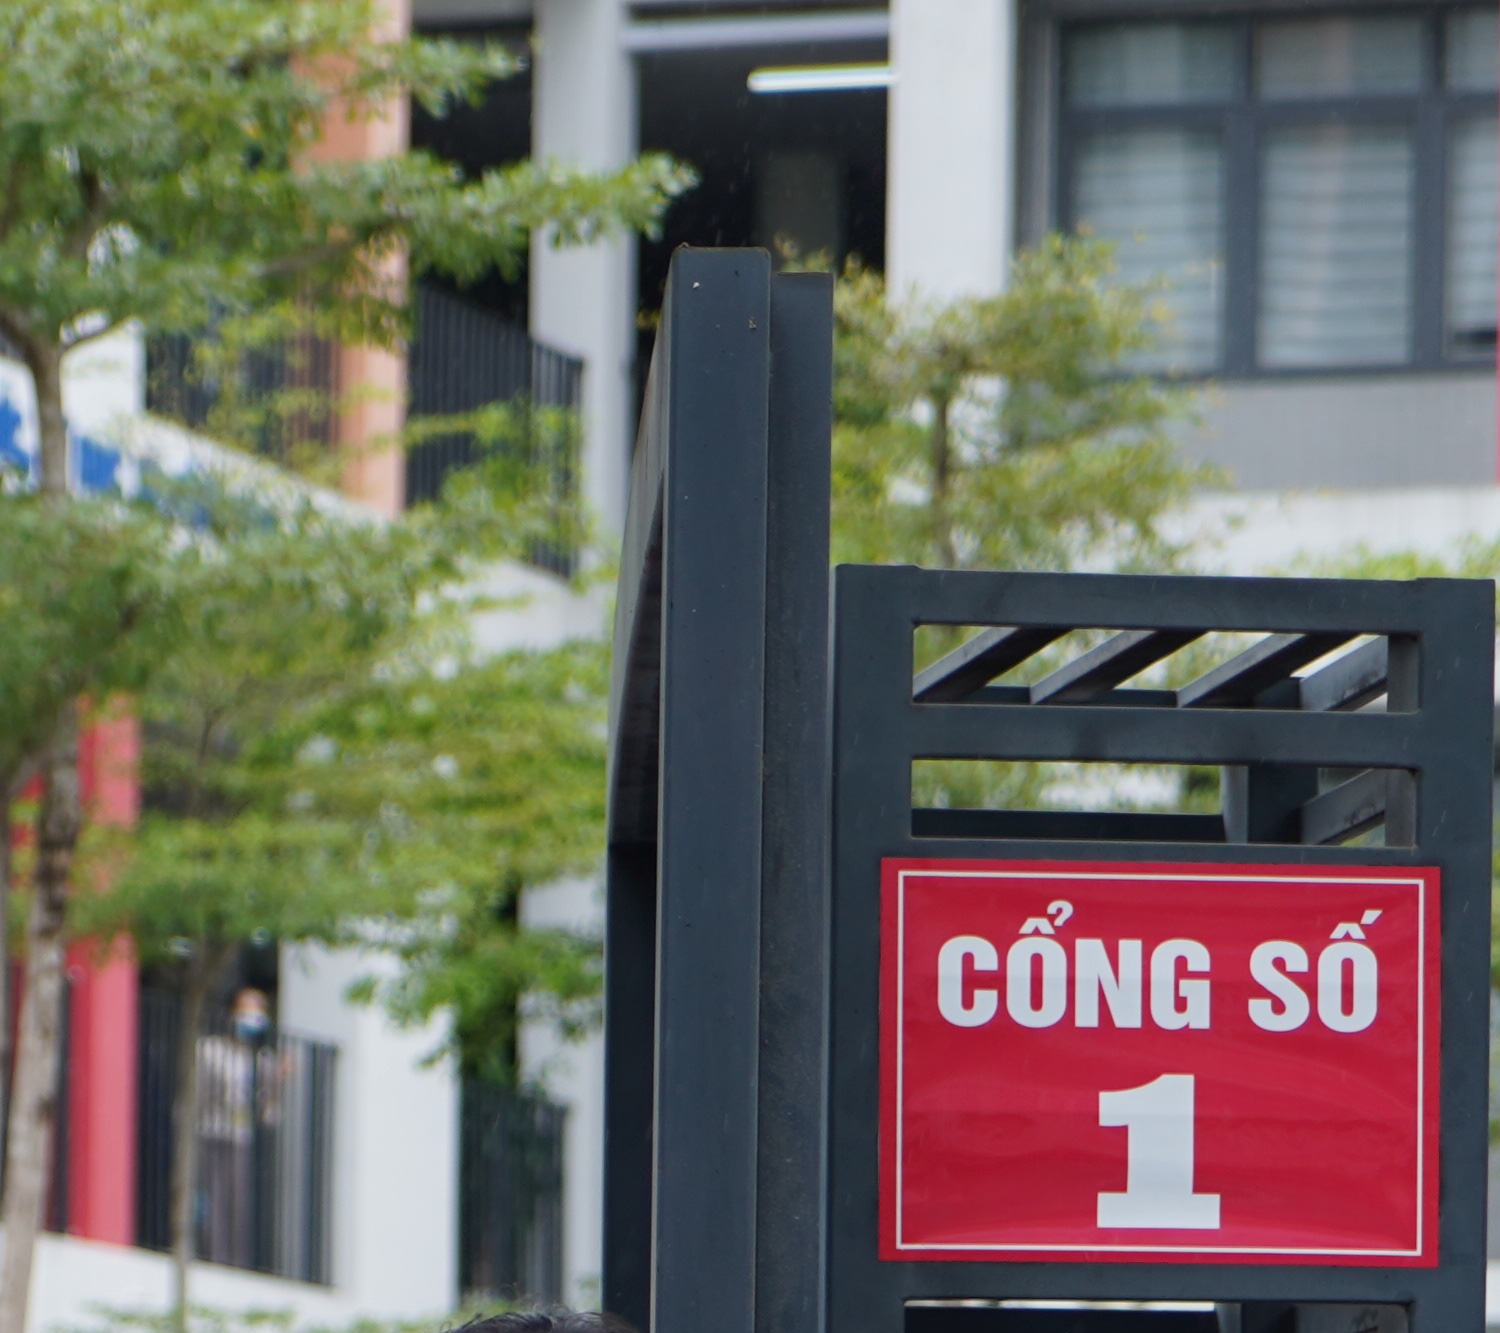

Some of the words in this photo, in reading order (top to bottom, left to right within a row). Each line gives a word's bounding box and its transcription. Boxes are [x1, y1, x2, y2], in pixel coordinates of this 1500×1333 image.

[938, 900, 1211, 1030] CỔNG
[1248, 910, 1383, 1033] SỐ
[1097, 1073, 1220, 1229] 1
